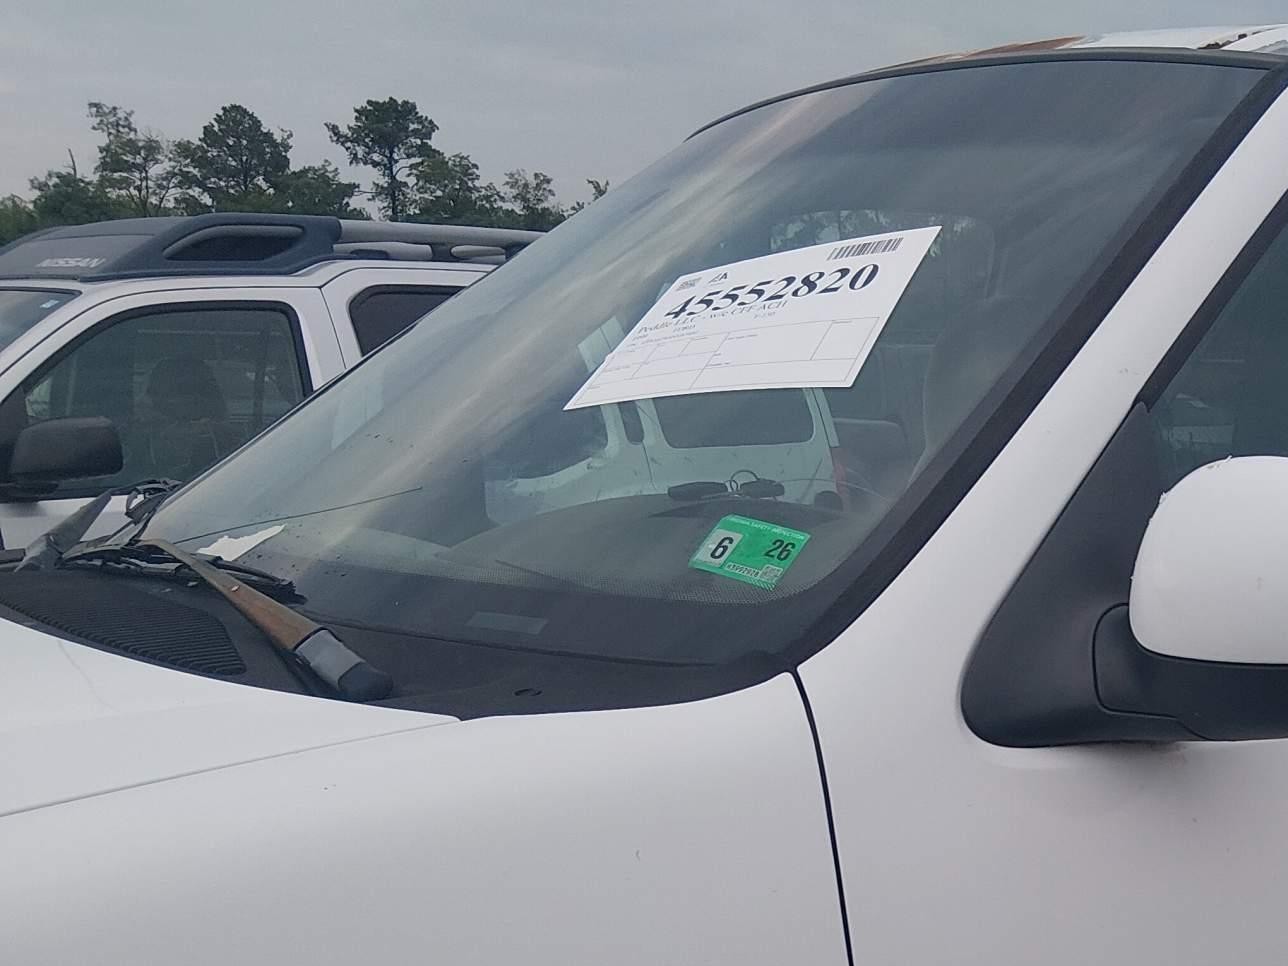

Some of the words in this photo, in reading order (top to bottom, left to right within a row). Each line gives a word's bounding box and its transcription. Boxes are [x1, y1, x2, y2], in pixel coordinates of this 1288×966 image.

[664, 263, 880, 320] 45552820
[710, 536, 734, 560] 6
[764, 539, 796, 561] 26
